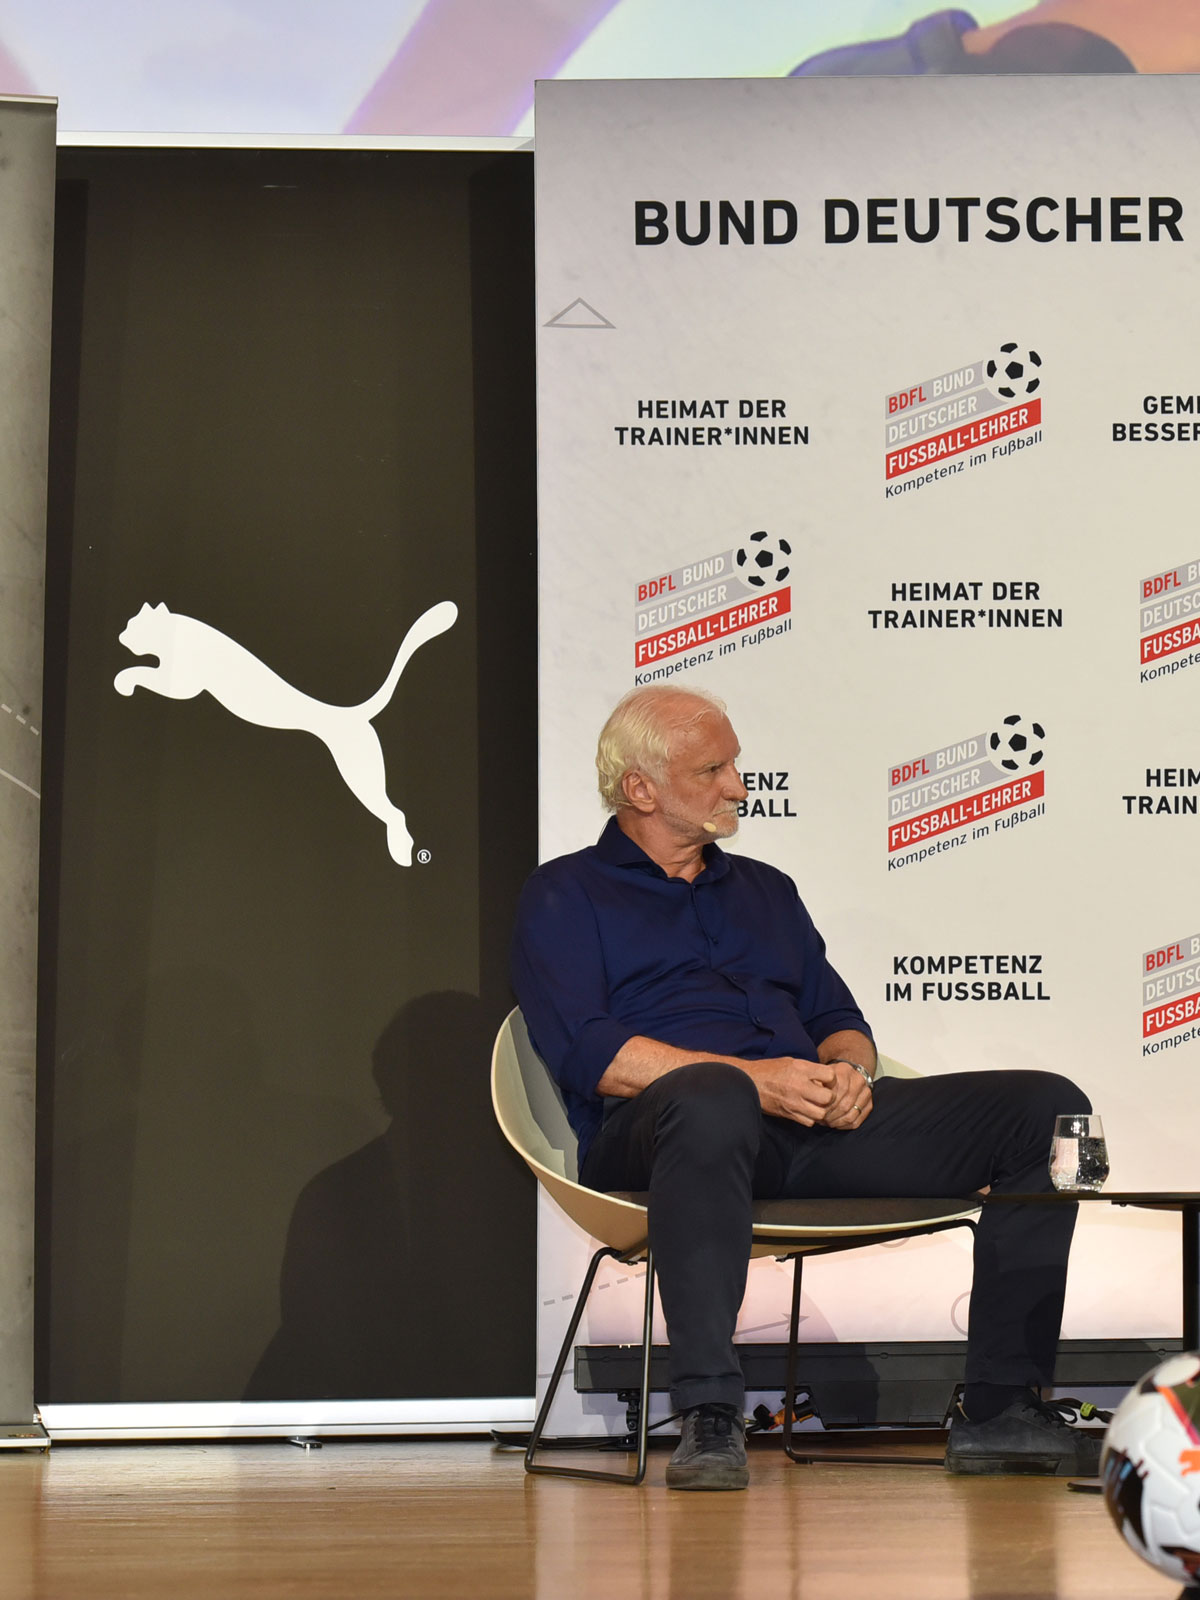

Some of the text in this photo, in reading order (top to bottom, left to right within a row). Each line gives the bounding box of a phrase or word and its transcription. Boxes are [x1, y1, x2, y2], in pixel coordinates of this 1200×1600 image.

[635, 199, 798, 246] BUND
[824, 196, 1184, 244] DEUTSCHER
[638, 399, 786, 419] HEIMAT DER
[889, 367, 975, 414] BDFL BUND
[889, 396, 977, 443] DEUTSCHER
[889, 408, 1029, 474] FUSSBALL-LEHRER
[885, 430, 1042, 498] Kompetenz im Fußball
[638, 556, 724, 603] BDFL BUND
[891, 582, 1040, 602] HEIMAT DER
[1144, 571, 1182, 599] BDFL
[638, 585, 726, 632] DEUTSCHER
[638, 597, 778, 663] FUSSBALL-LEHRER
[634, 619, 791, 687] Kompetenz im Fußball
[892, 739, 978, 786] BDFL BUND
[737, 799, 797, 817] BALL
[892, 768, 980, 815] DEUTSCHER
[892, 780, 1032, 846] FUSSBALL-LEHRER
[888, 802, 1045, 870] Kompetenz im Fußball
[893, 955, 1042, 975] KOMPETENZ
[1147, 944, 1185, 972] BDFL
[886, 981, 1051, 1002] IM FUSSBALL
